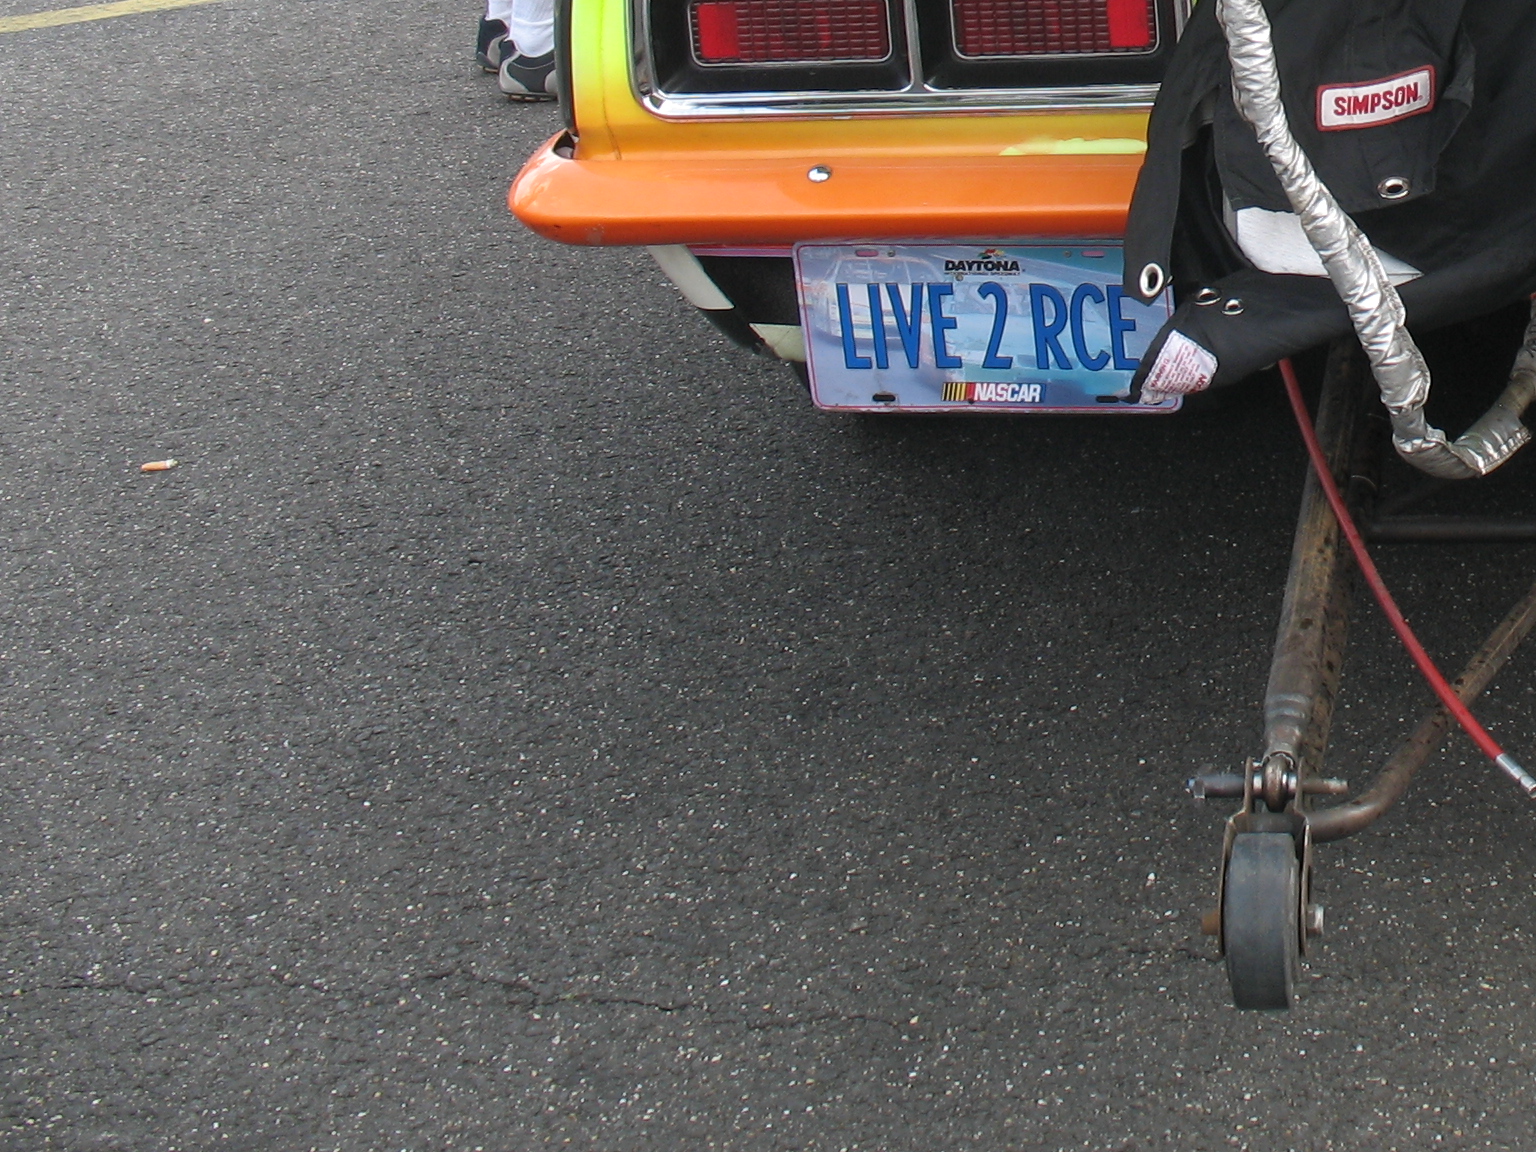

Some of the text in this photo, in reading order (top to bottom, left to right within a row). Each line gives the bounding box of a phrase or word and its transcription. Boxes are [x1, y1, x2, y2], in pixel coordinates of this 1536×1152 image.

[1333, 81, 1418, 116] SIMPSON
[944, 260, 1020, 272] DAYTONA
[836, 282, 963, 369] LIVE
[977, 282, 1014, 369] 2
[1029, 282, 1141, 371] RCE
[974, 383, 1041, 402] NASCAR
